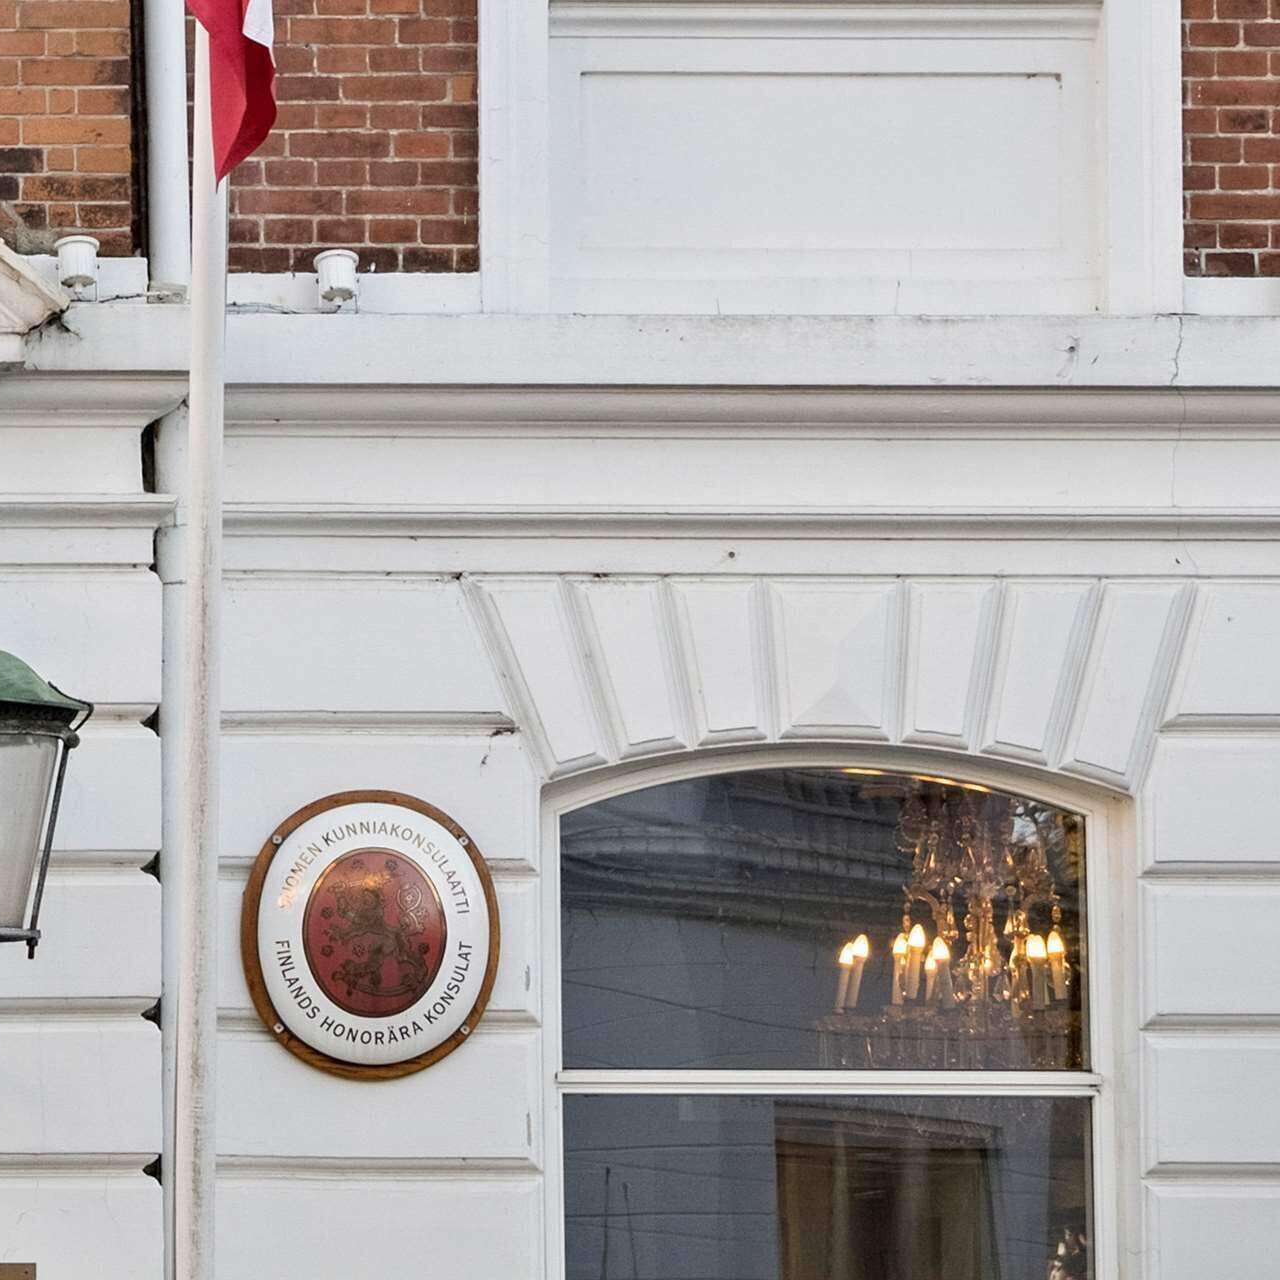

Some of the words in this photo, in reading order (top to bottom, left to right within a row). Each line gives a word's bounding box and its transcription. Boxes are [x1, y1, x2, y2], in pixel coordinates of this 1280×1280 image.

[321, 820, 470, 914] KUNNIAKONSULAATTI
[275, 940, 320, 1020] FINLANDS
[320, 1015, 423, 1045] HONORÄRA
[424, 942, 473, 1024] KONSULAT
